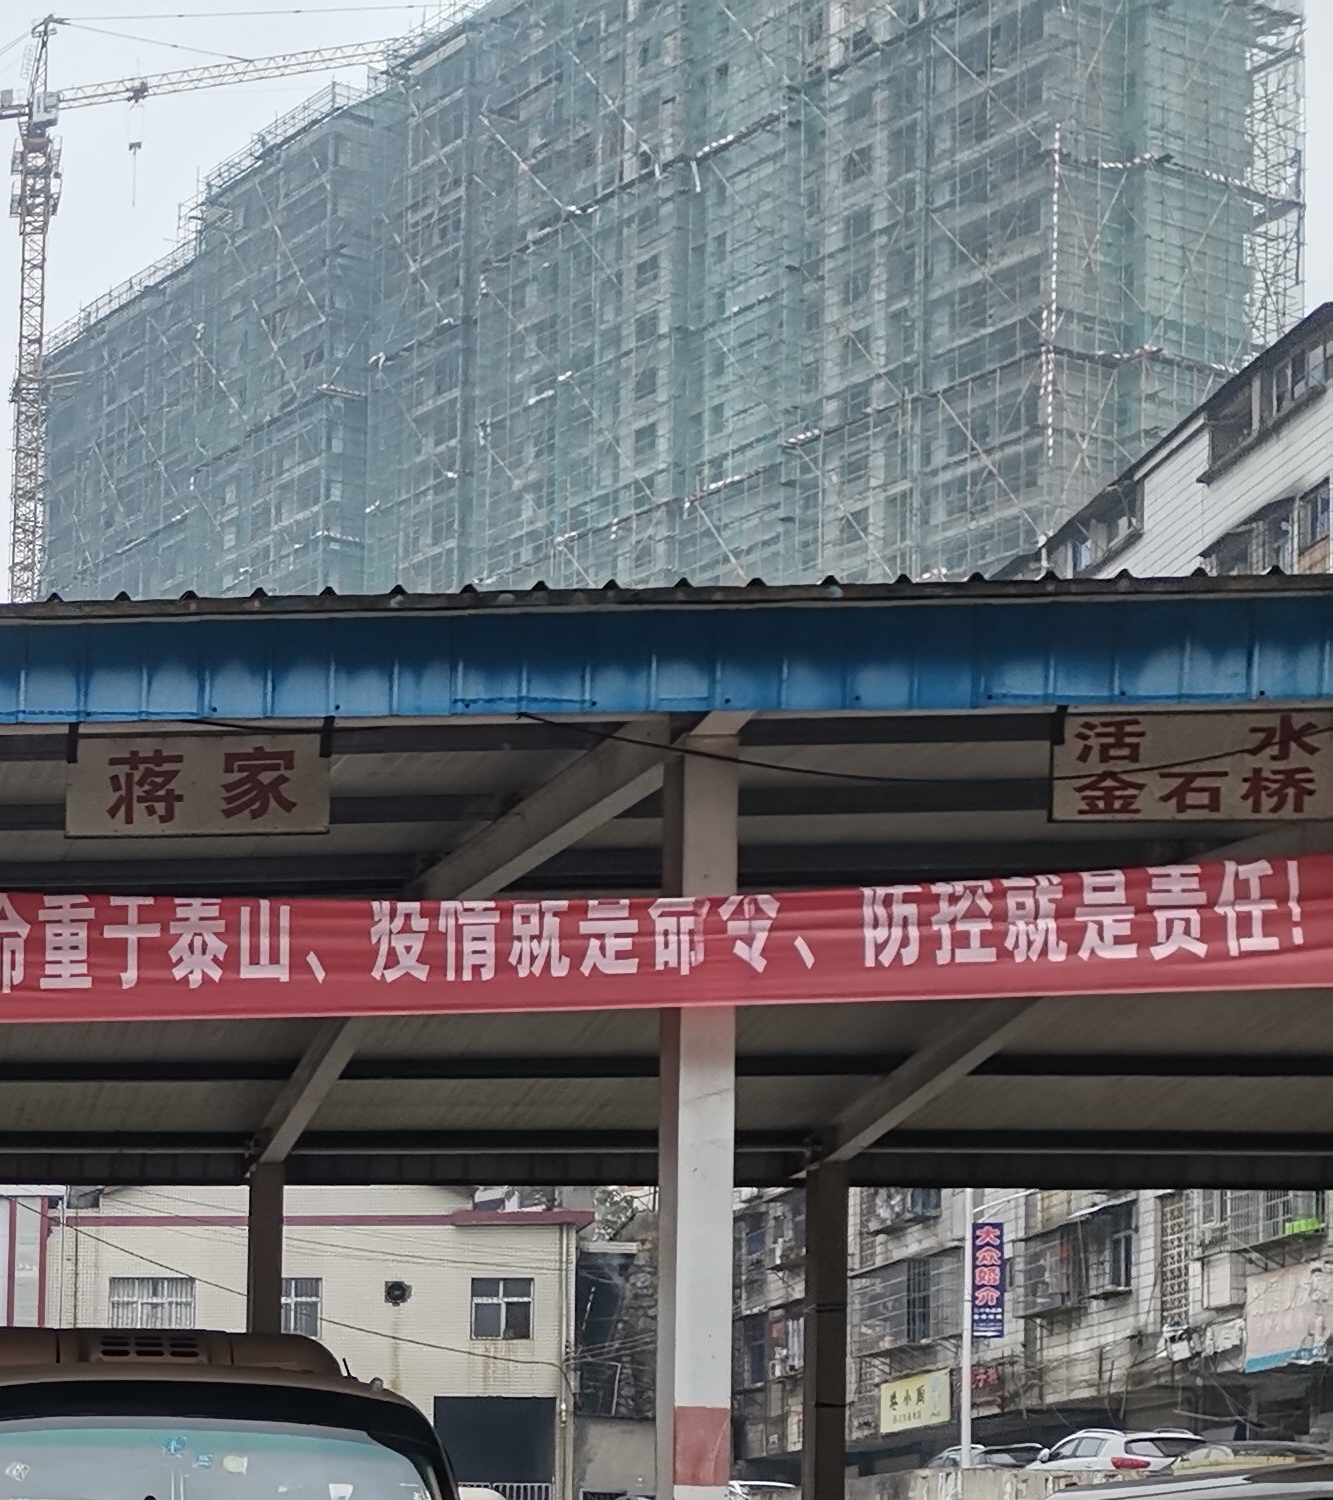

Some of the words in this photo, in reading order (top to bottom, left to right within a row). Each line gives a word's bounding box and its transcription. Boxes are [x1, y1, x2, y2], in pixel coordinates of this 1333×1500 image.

[1074, 712, 1322, 764] 活水
[105, 745, 298, 825] 蒋家
[1072, 766, 1317, 816] 金石桥
